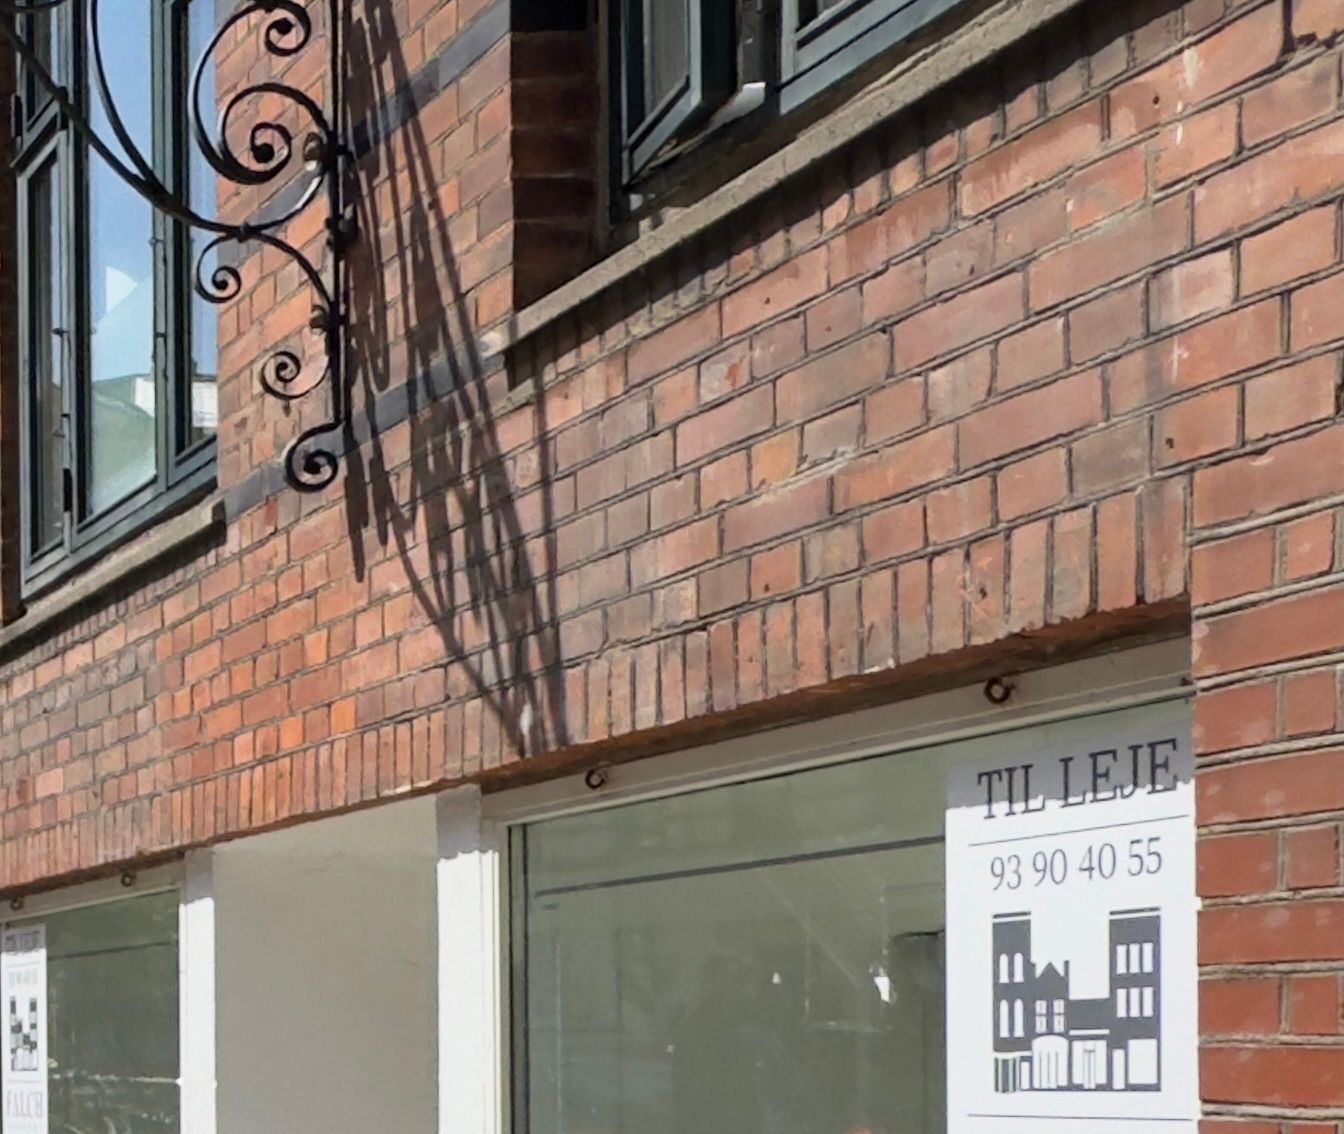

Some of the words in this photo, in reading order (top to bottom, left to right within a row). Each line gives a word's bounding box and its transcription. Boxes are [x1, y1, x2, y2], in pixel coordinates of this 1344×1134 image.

[977, 764, 1046, 820] TIL
[1059, 738, 1178, 809] LEJE
[990, 854, 1022, 891] 93
[1032, 849, 1068, 887] 90
[1079, 843, 1117, 881] 40
[1127, 837, 1163, 877] 55
